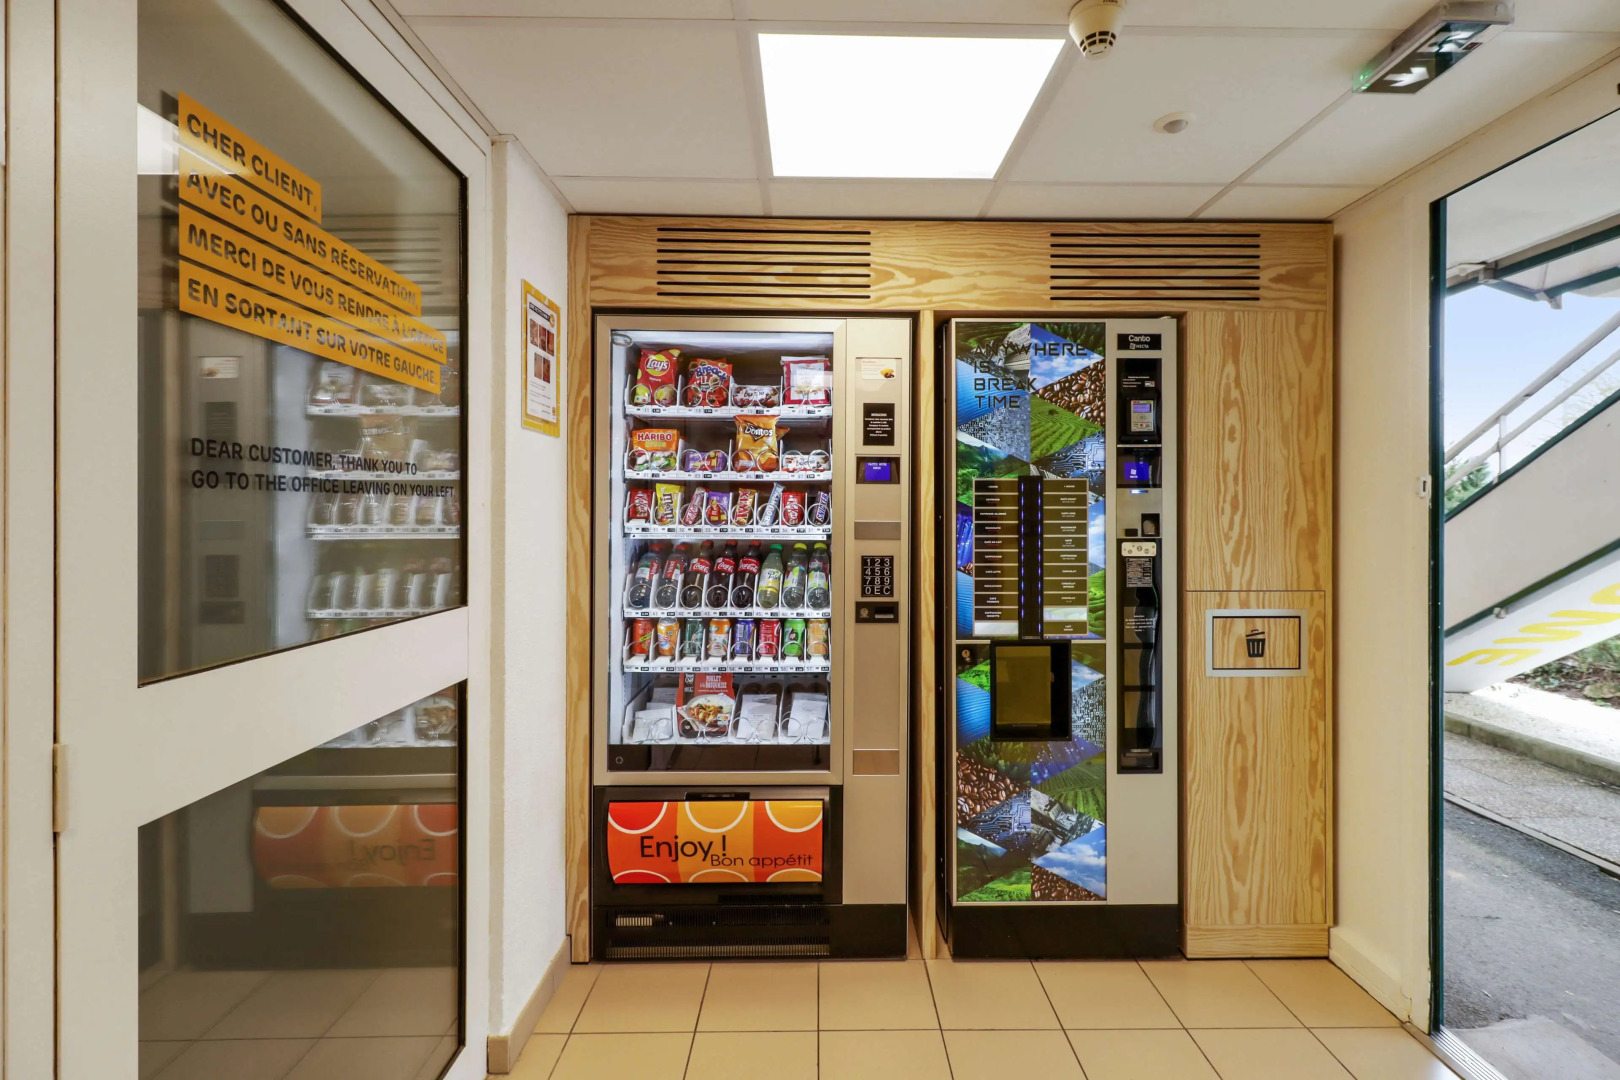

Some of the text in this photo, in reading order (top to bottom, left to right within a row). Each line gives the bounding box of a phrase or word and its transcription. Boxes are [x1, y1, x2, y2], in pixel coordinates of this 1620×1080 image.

[187, 113, 247, 166] CHER
[187, 170, 246, 216] AVEC
[250, 203, 279, 233] OU
[282, 221, 327, 258] SANS
[188, 224, 257, 272] MERCI
[262, 257, 286, 284] DE
[289, 269, 335, 306] VOUS
[338, 293, 390, 331] RENDRE
[392, 315, 401, 336] À
[188, 278, 438, 386] EN SORTANT SUR VOTRE GAUCHE.
[974, 342, 1087, 356] ANYWHERE
[646, 358, 669, 371] Lay's
[974, 361, 991, 373] IS
[974, 378, 1037, 391] BREAK
[974, 395, 1020, 408] TIME
[637, 433, 672, 441] HARIBO
[744, 426, 773, 437] Doritos
[191, 437, 418, 476] DEAR CUSTOMER, THANK YOU TO
[191, 470, 456, 498] GO TO THE OFFICE LEAVING ON YOUR LEFT.
[866, 558, 890, 567] 1 2 3
[865, 568, 890, 576] 4 5 6
[865, 577, 890, 585] 7 8 9
[865, 586, 890, 595] 0 E C
[710, 854, 813, 868] Bon appétit
